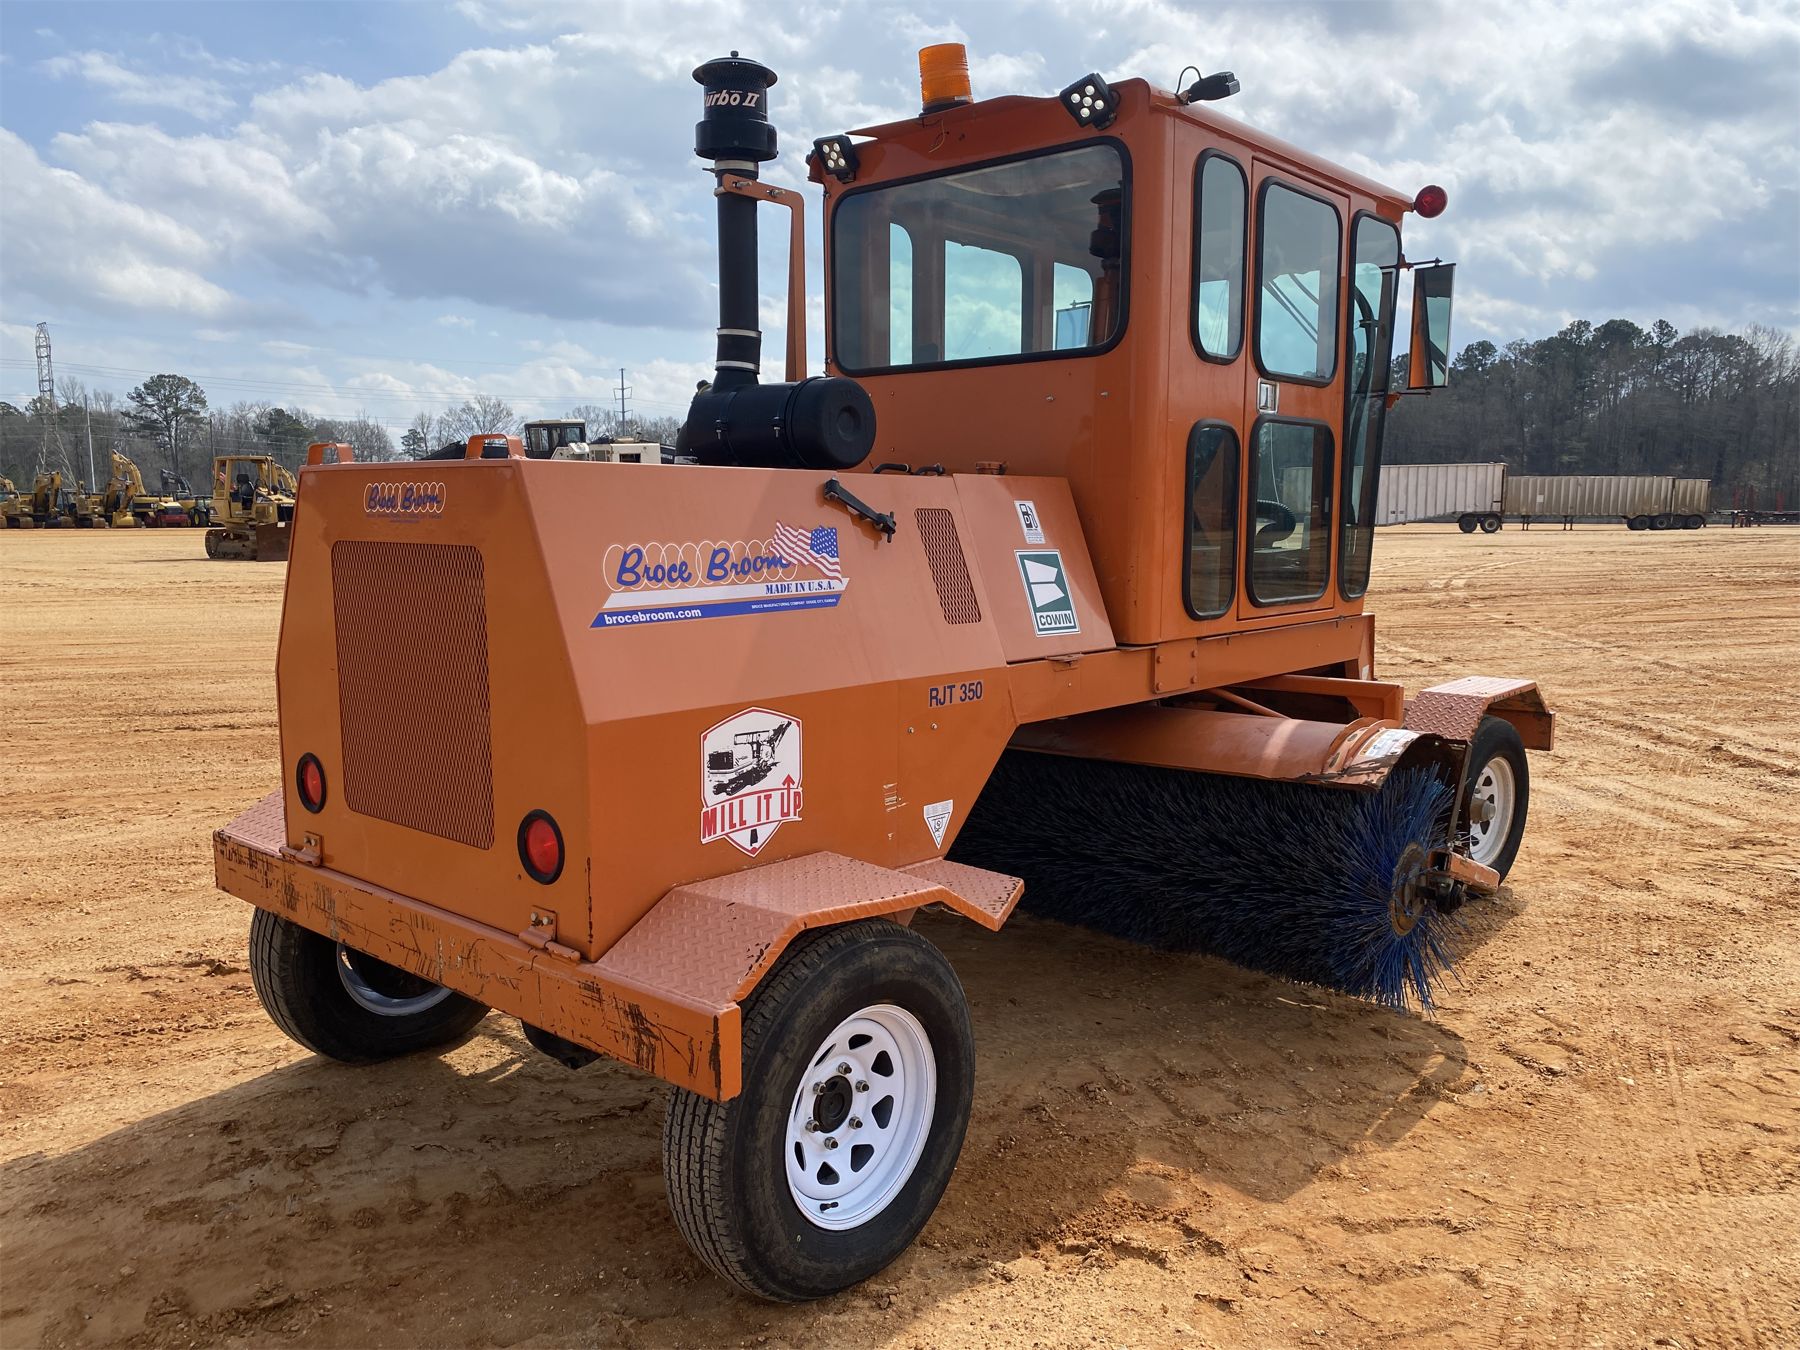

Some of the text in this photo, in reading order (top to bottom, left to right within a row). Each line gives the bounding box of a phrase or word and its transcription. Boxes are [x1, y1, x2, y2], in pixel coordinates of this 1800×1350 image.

[705, 90, 760, 107] urbo II
[616, 548, 791, 586] Broce Broom
[765, 580, 835, 595] MADE IN U.S.A.
[604, 609, 702, 625] brocebroom.com
[1039, 613, 1072, 626] COWIN
[929, 681, 983, 708] RJT 350
[702, 786, 802, 840] MILL IT UP
